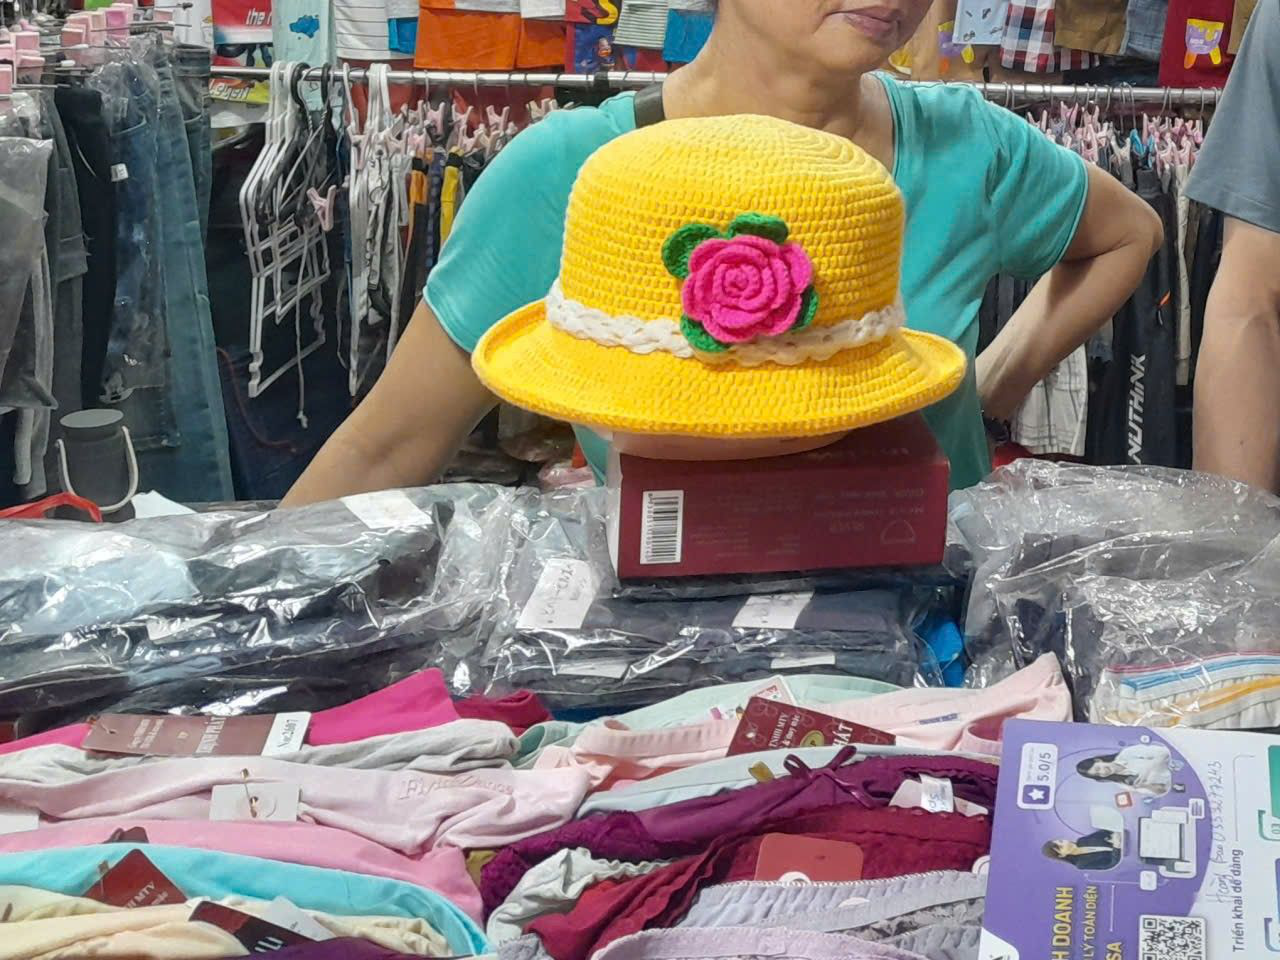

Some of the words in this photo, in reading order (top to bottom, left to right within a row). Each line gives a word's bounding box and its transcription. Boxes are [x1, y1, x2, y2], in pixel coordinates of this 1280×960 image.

[1037, 751, 1052, 782] 5.0/5
[1271, 823, 1280, 835] 03
[1230, 849, 1244, 876] dàng
[1083, 886, 1098, 910] DIỆN
[1231, 895, 1244, 919] khai
[1053, 887, 1073, 947] DOANH
[1081, 911, 1097, 941] TOÀN
